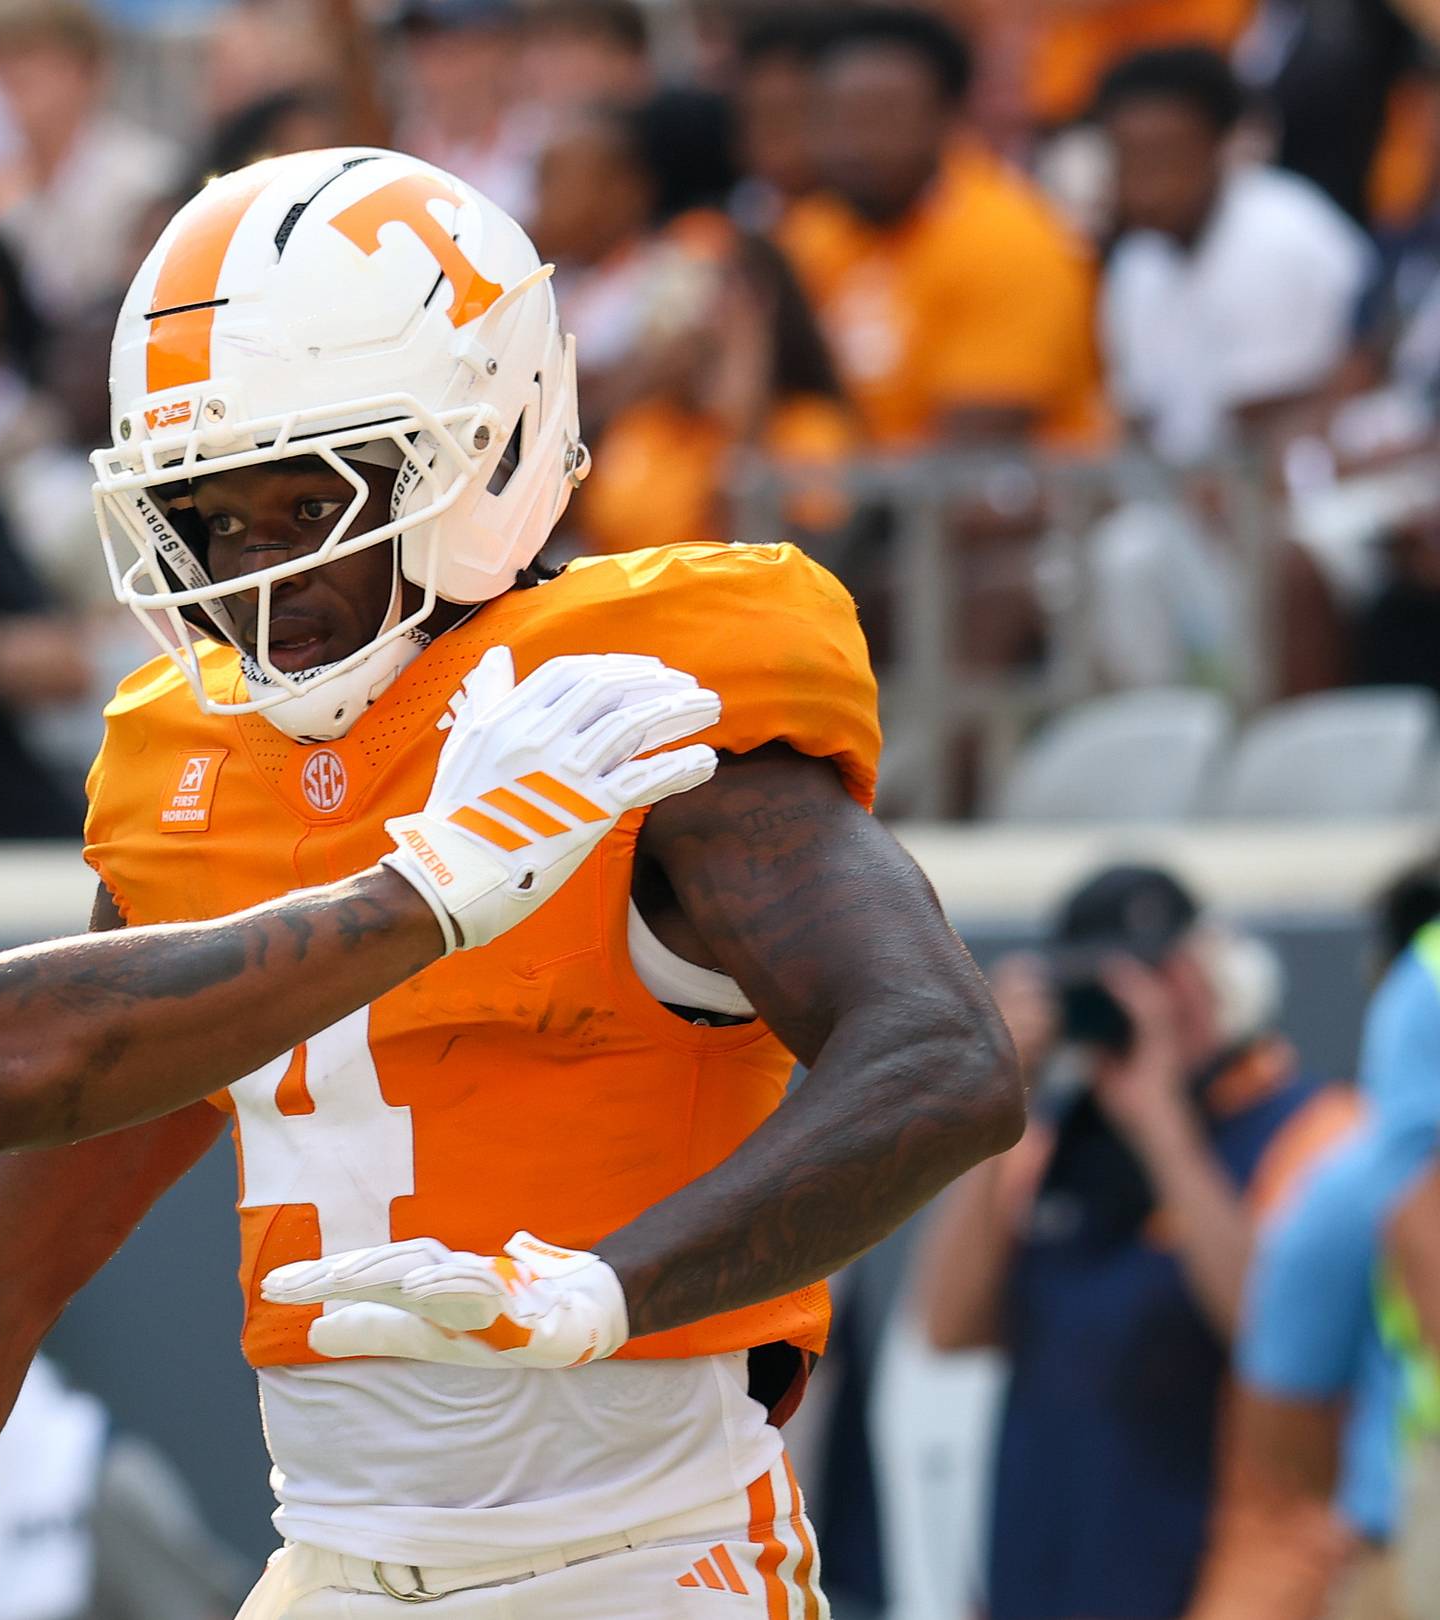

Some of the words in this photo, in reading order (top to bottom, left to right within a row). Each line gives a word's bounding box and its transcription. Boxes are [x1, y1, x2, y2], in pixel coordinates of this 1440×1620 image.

[328, 174, 505, 329] T
[141, 507, 180, 553] SPORT
[172, 795, 200, 807] FIRST
[305, 754, 343, 807] SEC
[161, 809, 207, 823] HORIZON
[401, 830, 454, 887] ADIZERO
[226, 1002, 415, 1259] 4
